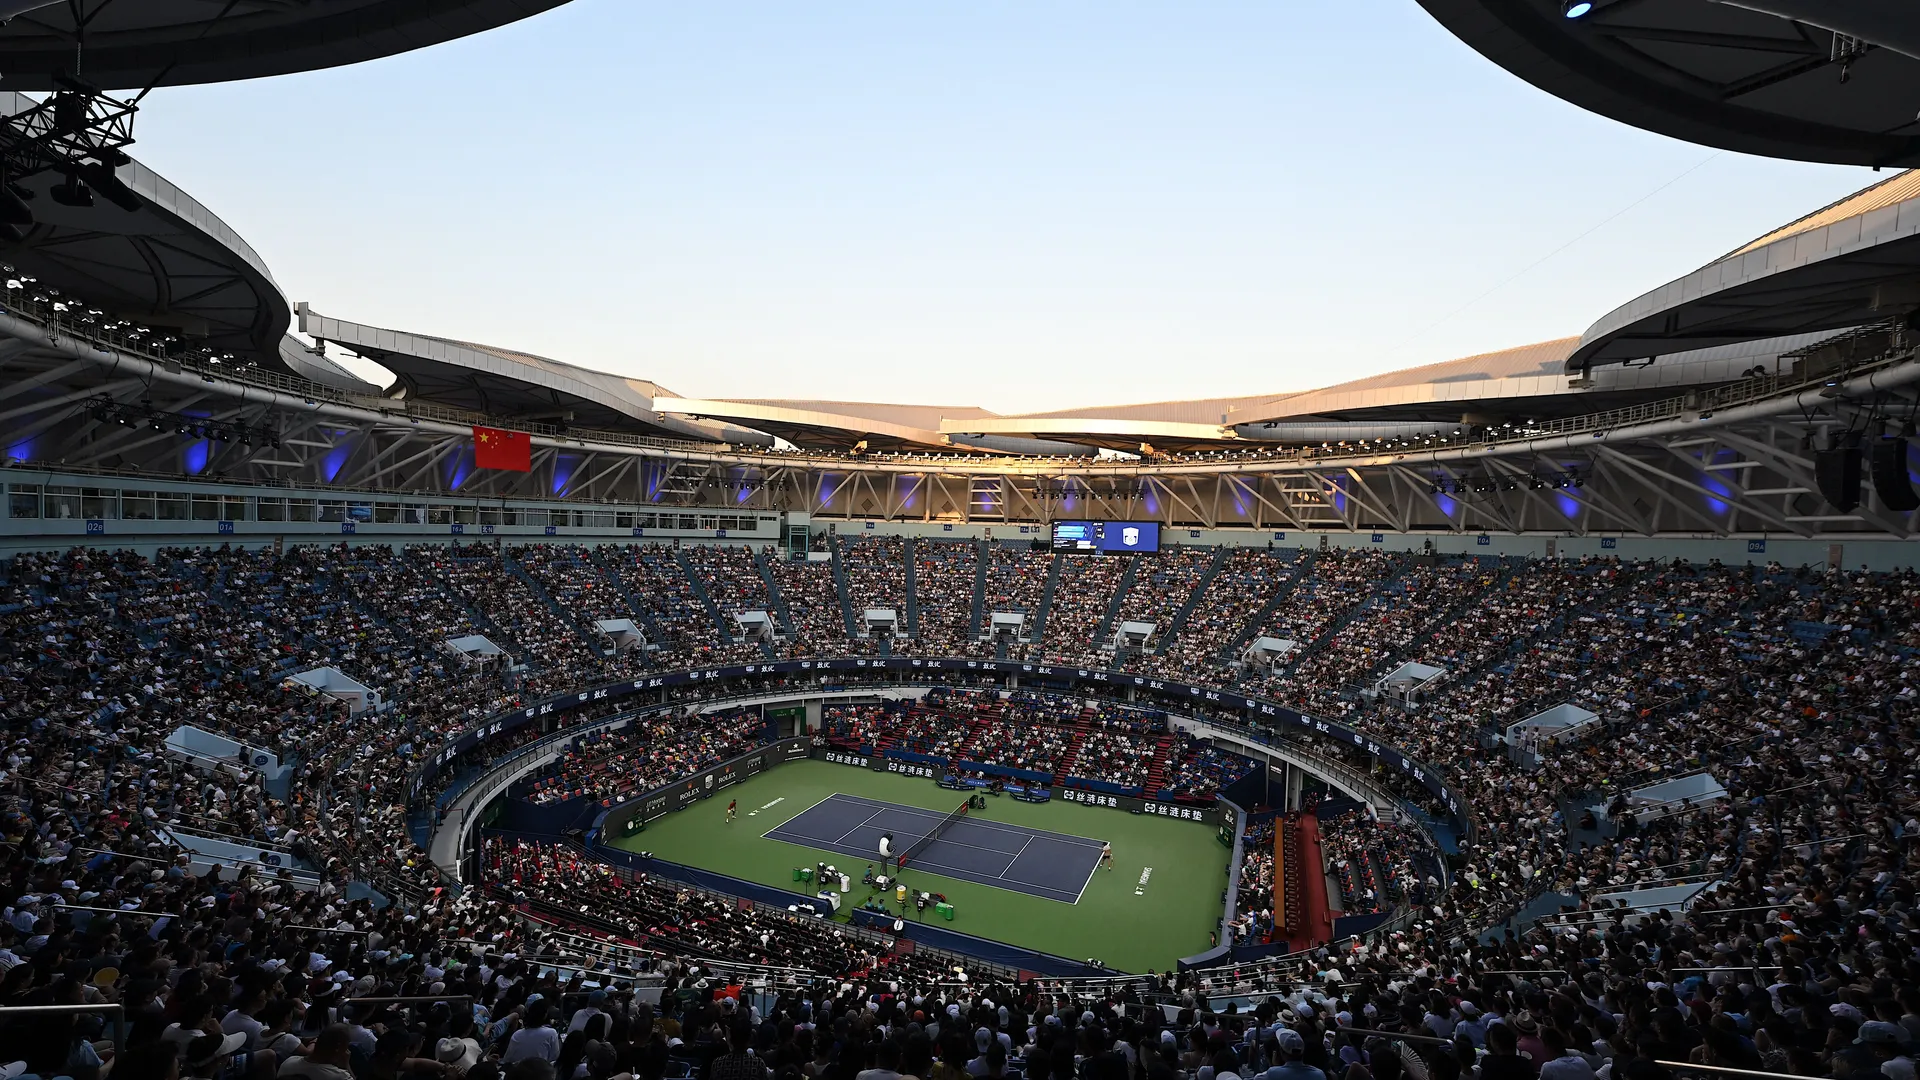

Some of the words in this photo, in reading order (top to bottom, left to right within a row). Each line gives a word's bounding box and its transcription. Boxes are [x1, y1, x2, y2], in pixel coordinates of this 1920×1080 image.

[88, 523, 103, 531] 02B
[718, 771, 736, 783] ROLEX
[680, 787, 700, 800] ROLEX
